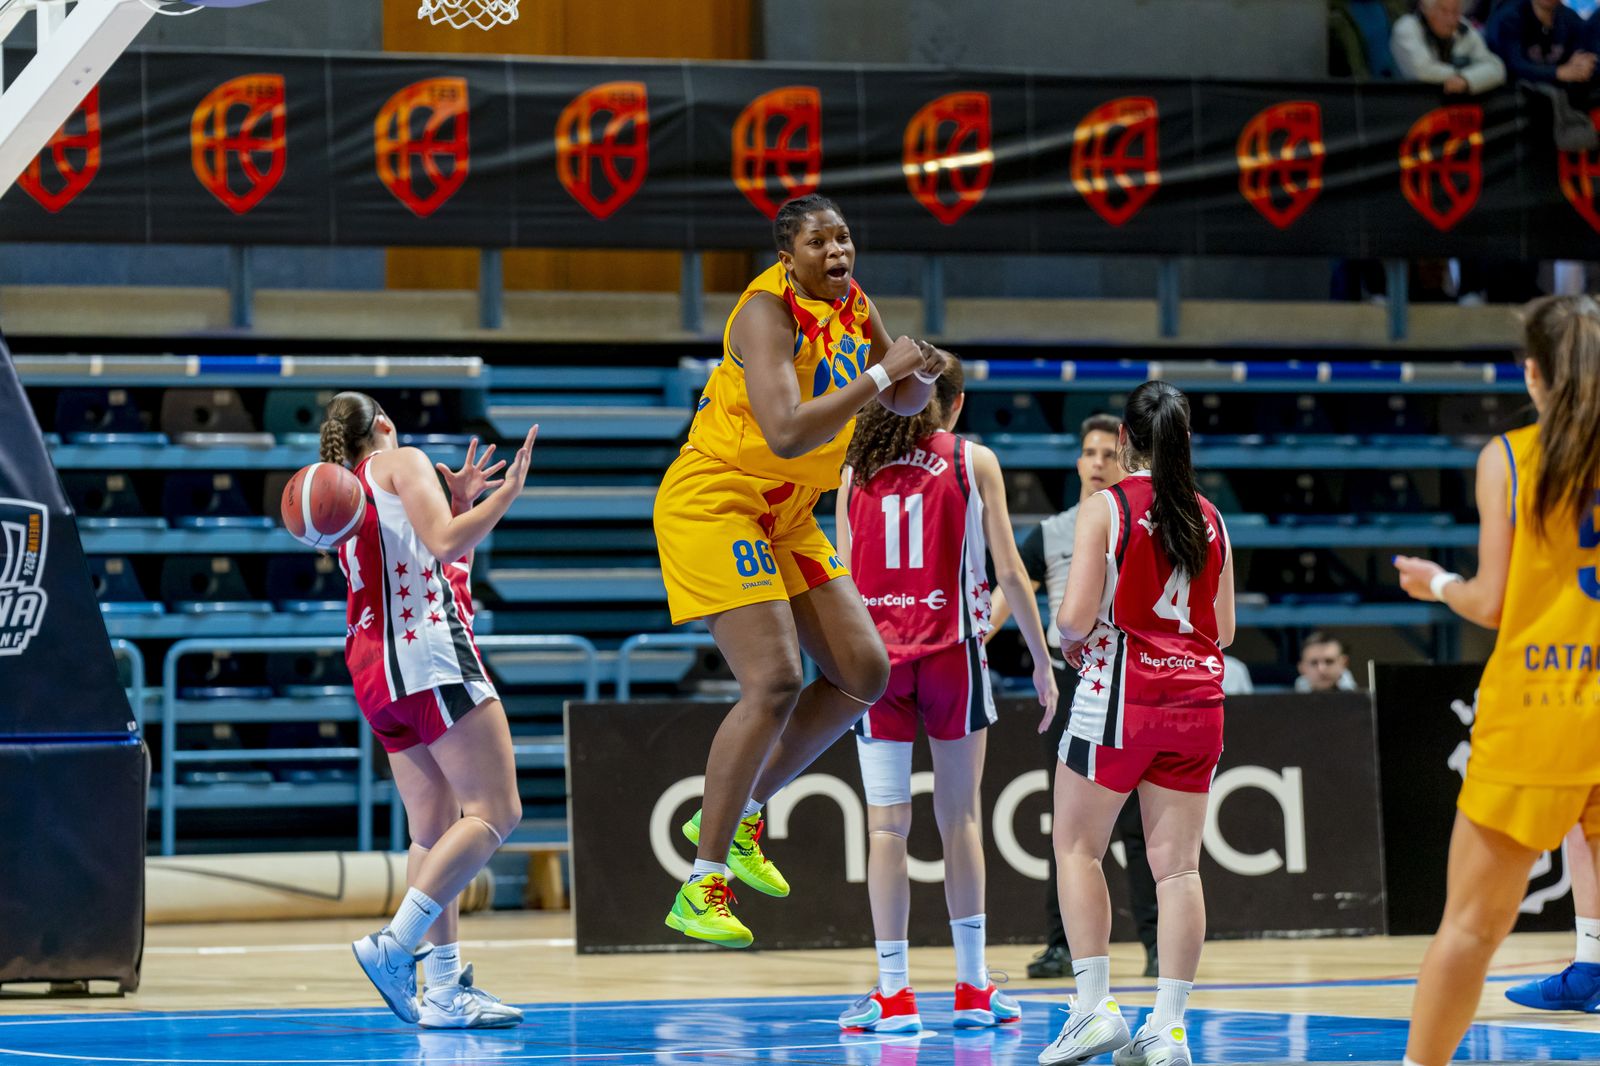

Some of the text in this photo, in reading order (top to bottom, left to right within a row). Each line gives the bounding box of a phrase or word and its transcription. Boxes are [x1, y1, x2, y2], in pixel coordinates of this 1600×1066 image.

[881, 493, 924, 569] 11
[732, 539, 777, 577] 86
[742, 579, 772, 590] SPALDING
[1152, 562, 1194, 634] 4
[862, 593, 915, 608] berCaja
[1140, 652, 1196, 671] iberCaja
